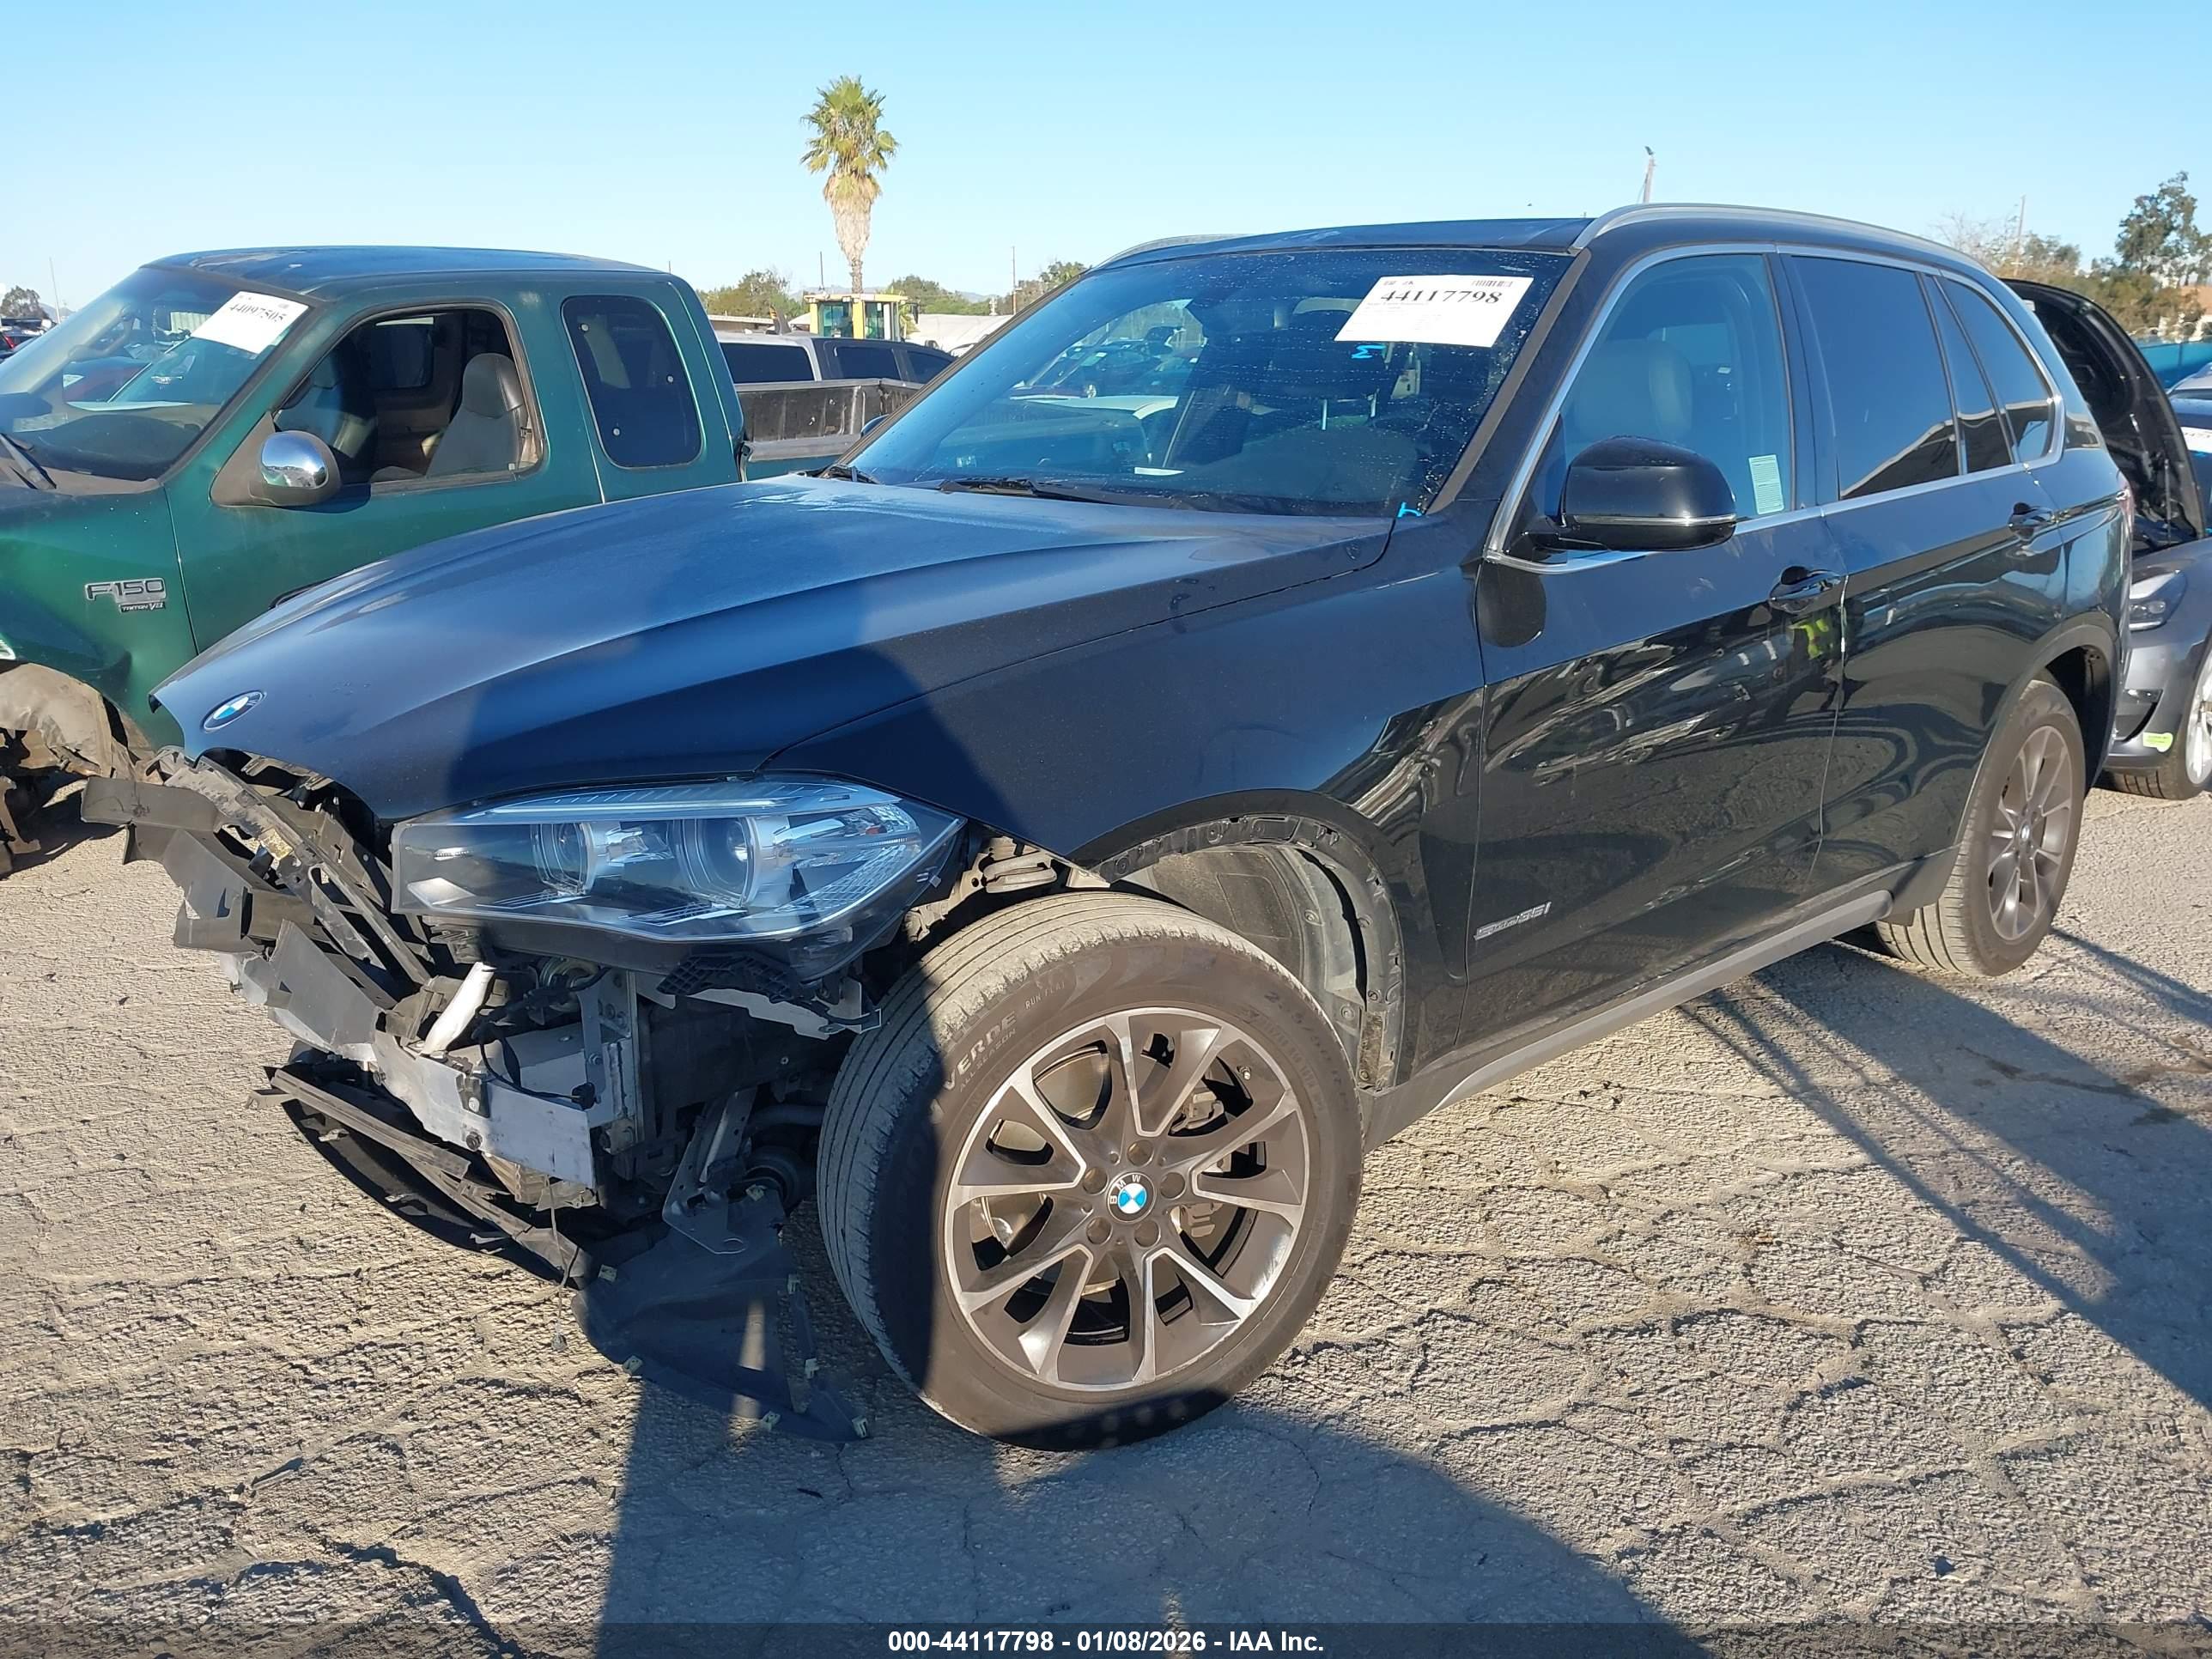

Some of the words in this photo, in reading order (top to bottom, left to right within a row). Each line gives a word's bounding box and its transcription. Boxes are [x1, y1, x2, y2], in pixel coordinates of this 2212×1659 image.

[1381, 290, 1503, 305] 44117798
[943, 1011, 1017, 1091] VERDE
[1109, 1174, 1141, 1205] BMW
